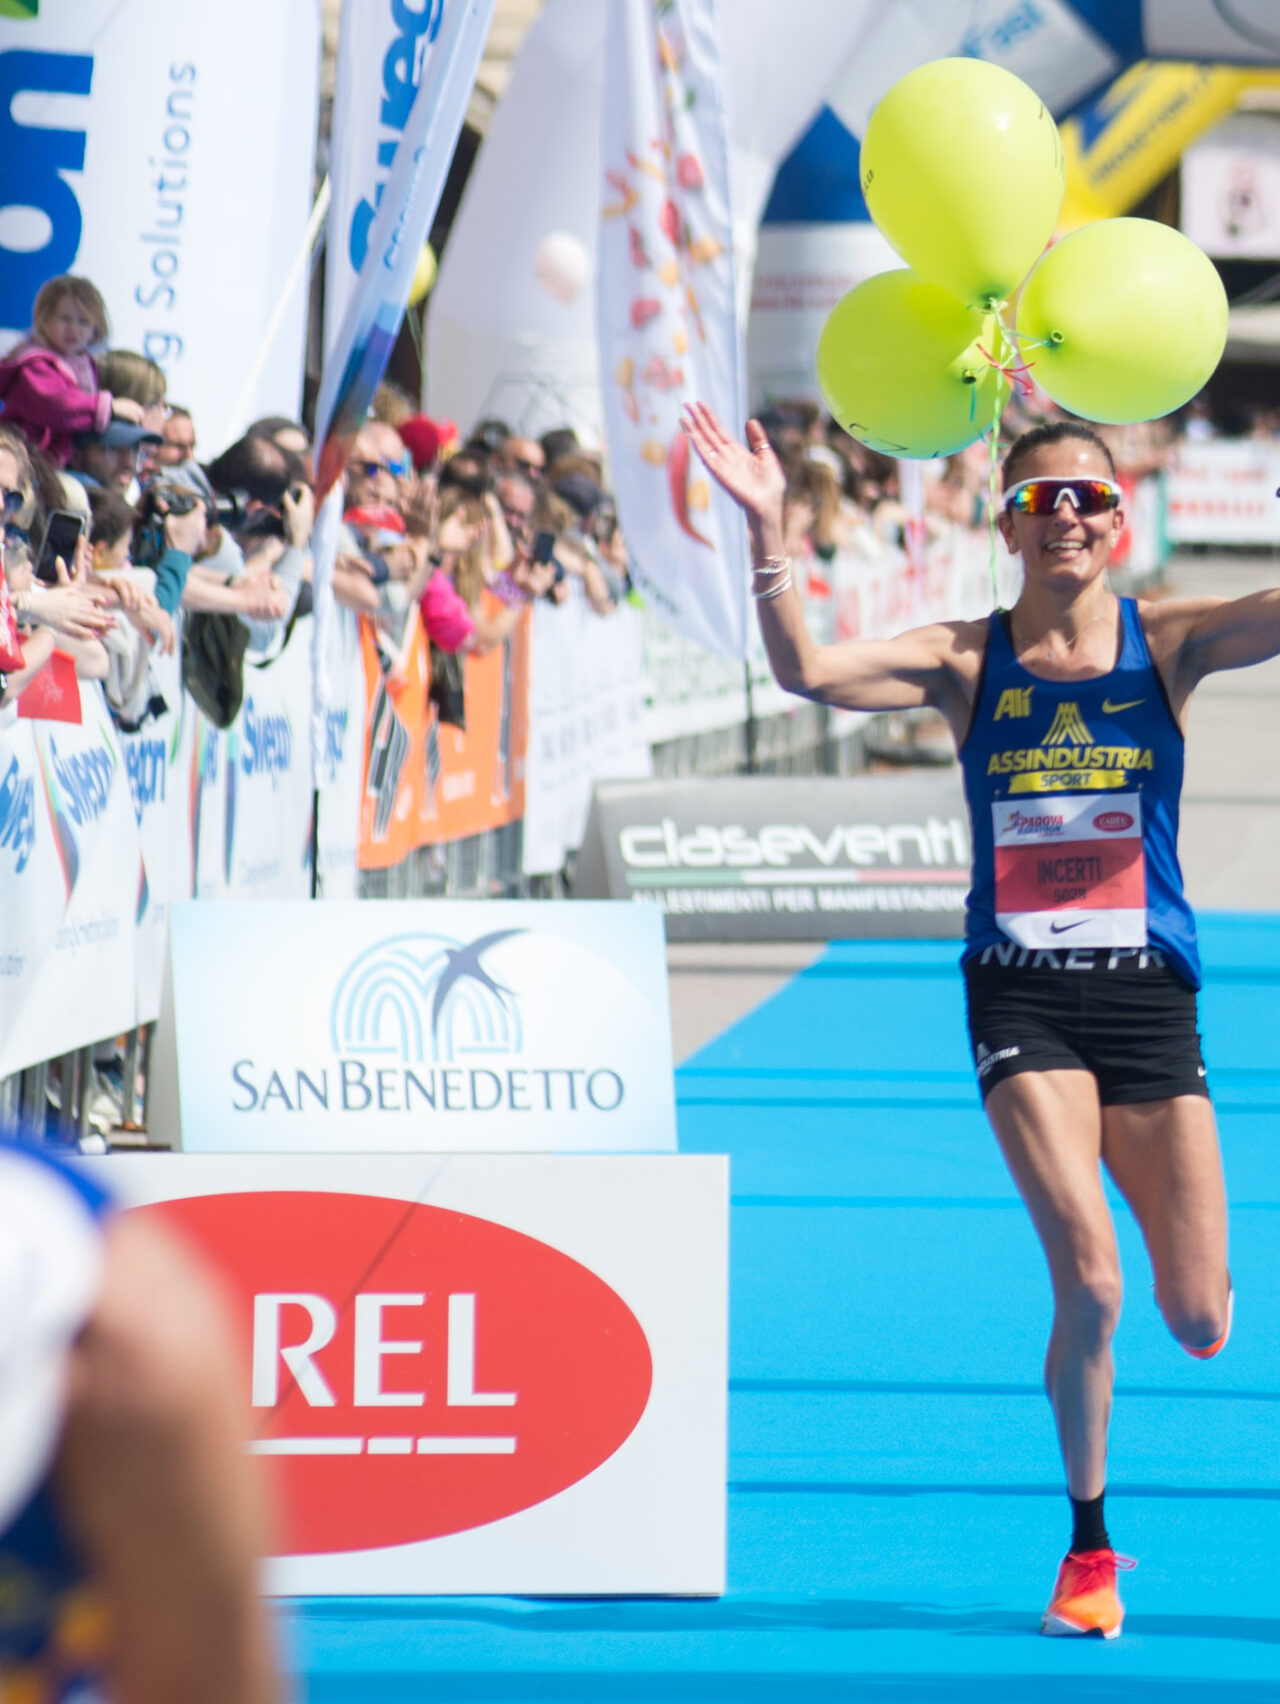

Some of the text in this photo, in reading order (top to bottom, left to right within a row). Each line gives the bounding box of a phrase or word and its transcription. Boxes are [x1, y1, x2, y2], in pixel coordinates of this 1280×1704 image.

[133, 60, 198, 311] Solutions
[986, 746, 1154, 776] ASSINDUSTRIA
[1039, 772, 1093, 788] SPORT
[1020, 814, 1064, 827] PADOVA
[618, 815, 969, 868] claseventi
[1037, 857, 1103, 885] INCERTI
[773, 887, 815, 912] PER
[979, 942, 1095, 970] NIKE
